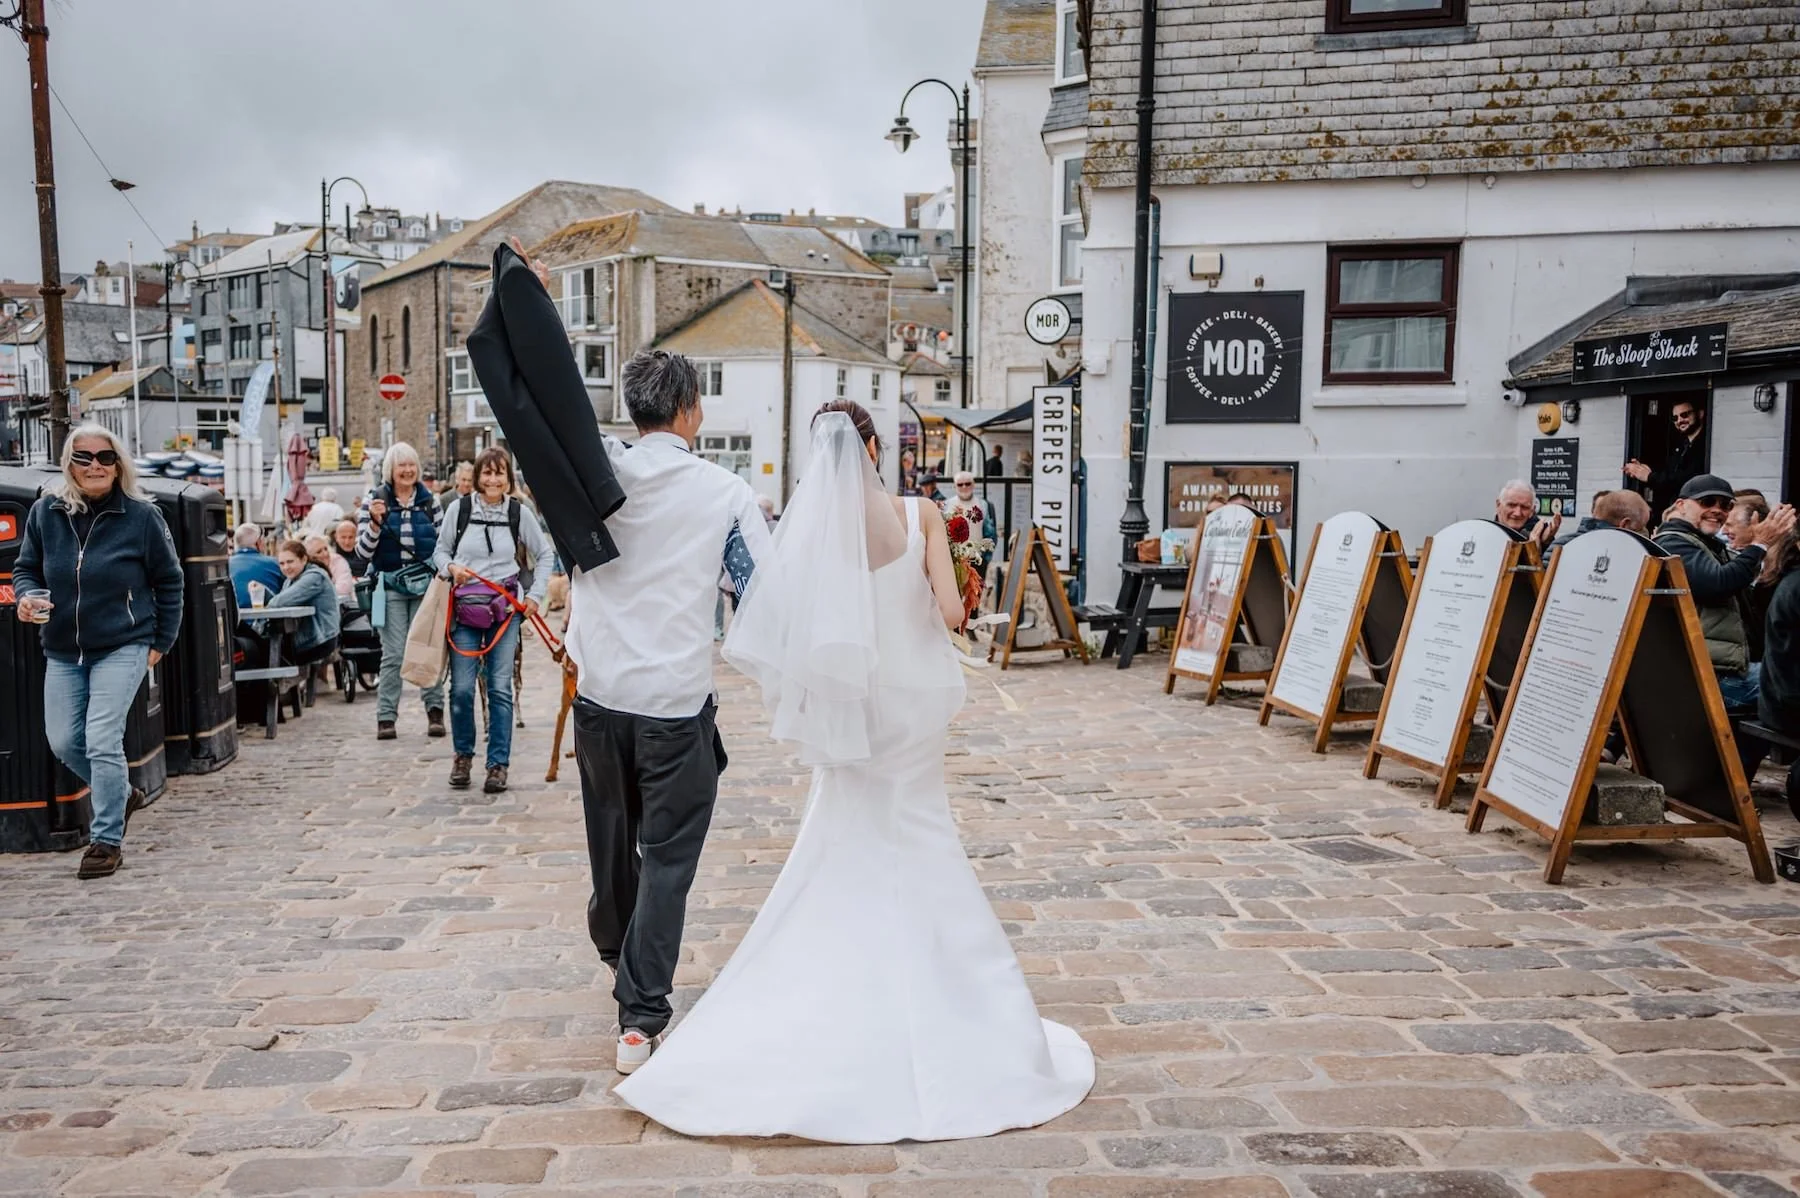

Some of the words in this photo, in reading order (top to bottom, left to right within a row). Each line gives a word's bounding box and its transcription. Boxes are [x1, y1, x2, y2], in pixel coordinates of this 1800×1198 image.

[1036, 313, 1060, 328] MOR
[1186, 318, 1214, 352] COFFEE
[1222, 310, 1247, 320] DELI
[1255, 316, 1284, 350] BAKERY
[1202, 338, 1266, 377] MOR
[1592, 346, 1615, 367] The
[1615, 343, 1653, 368] Sloop
[1654, 335, 1700, 361] Shack
[1185, 365, 1213, 399] COFFEE
[1220, 396, 1245, 406] DELI
[1253, 364, 1283, 399] BAKERY
[1041, 395, 1068, 475] CRÊPES
[1229, 484, 1280, 497] WINNING
